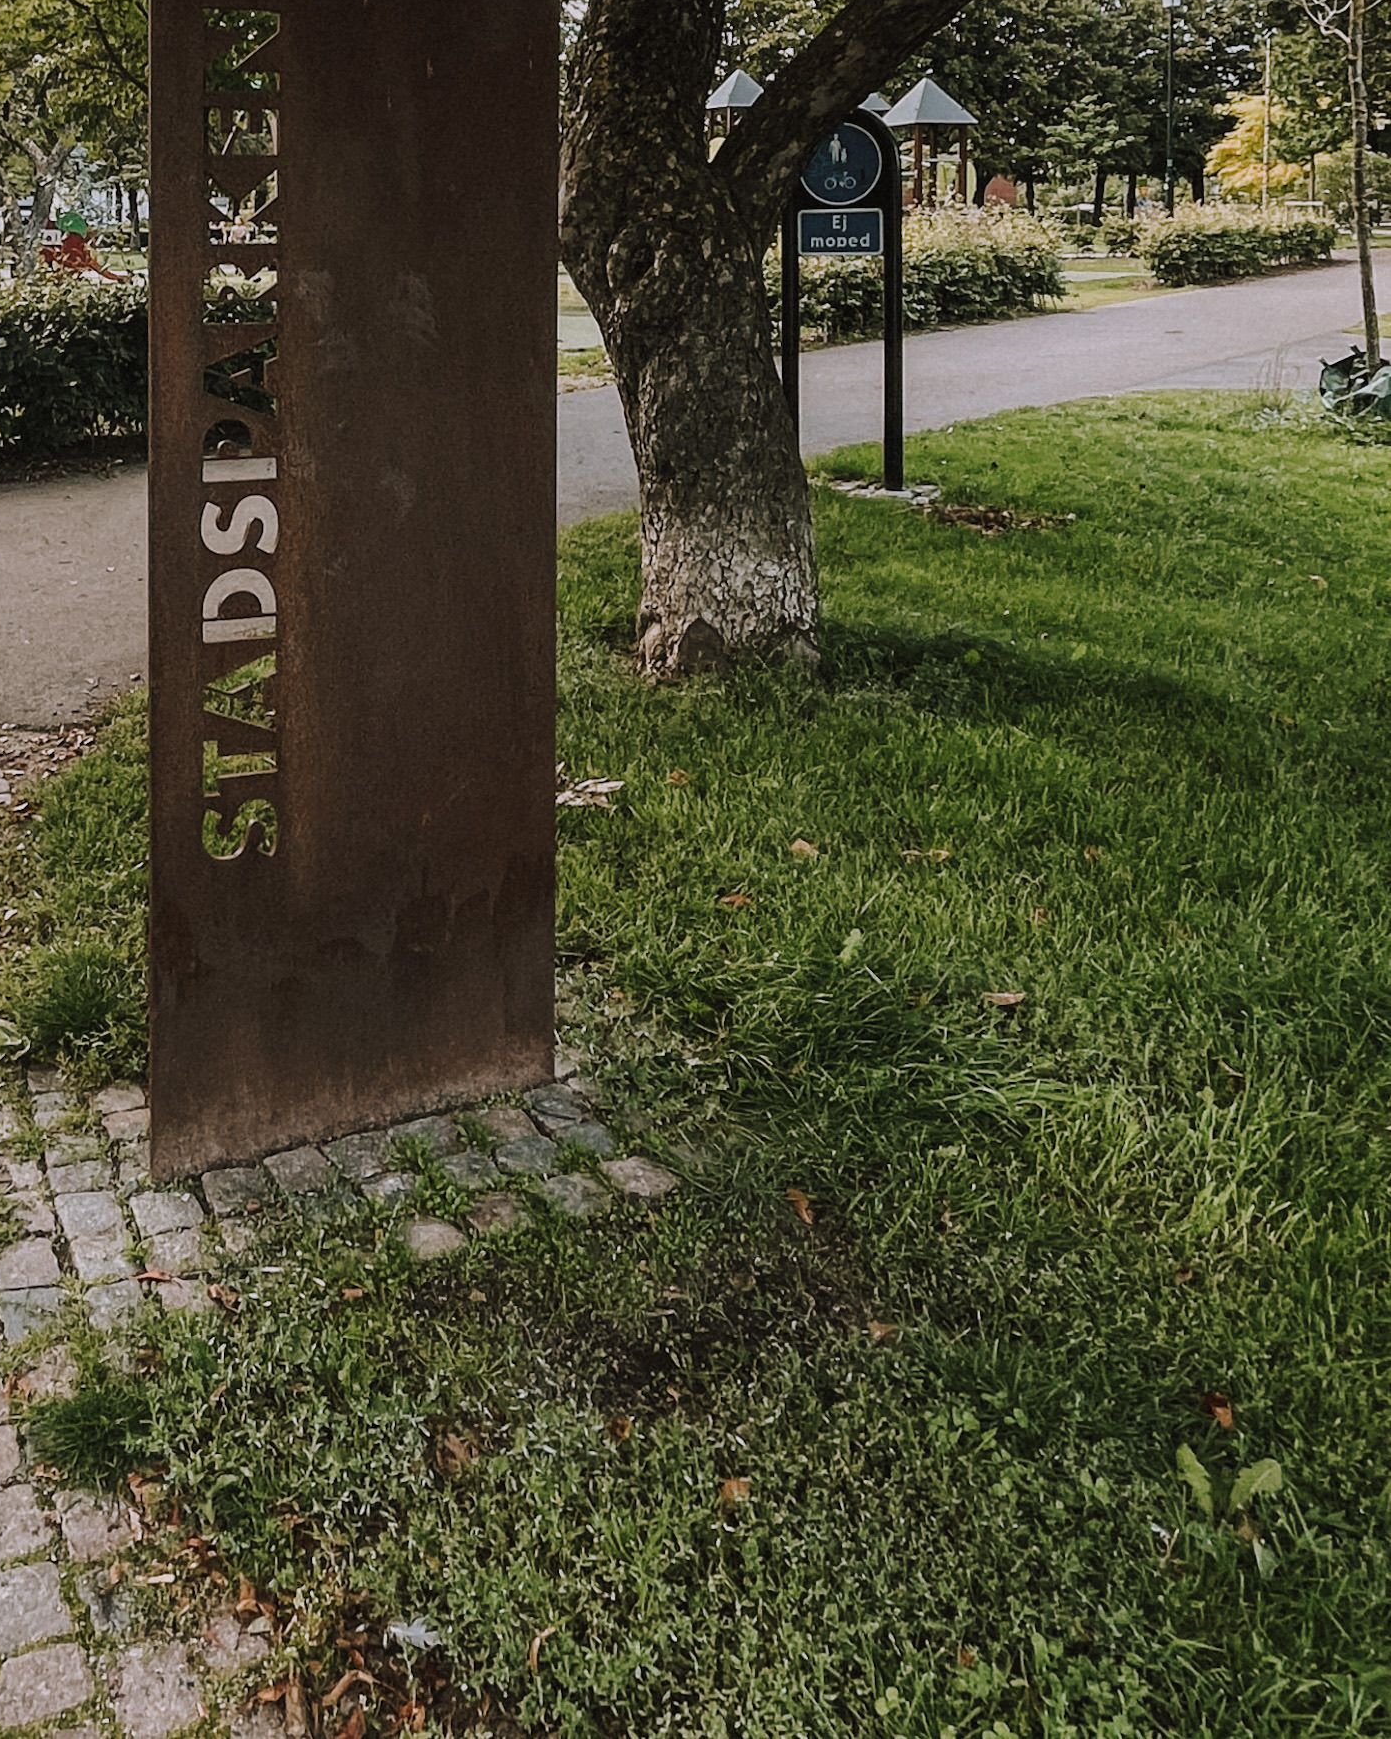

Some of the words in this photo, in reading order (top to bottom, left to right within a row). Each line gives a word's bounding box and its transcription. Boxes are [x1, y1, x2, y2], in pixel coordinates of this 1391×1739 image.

[832, 214, 847, 232] Ej
[810, 233, 870, 248] moped
[200, 7, 281, 861] STADSPARKEN
